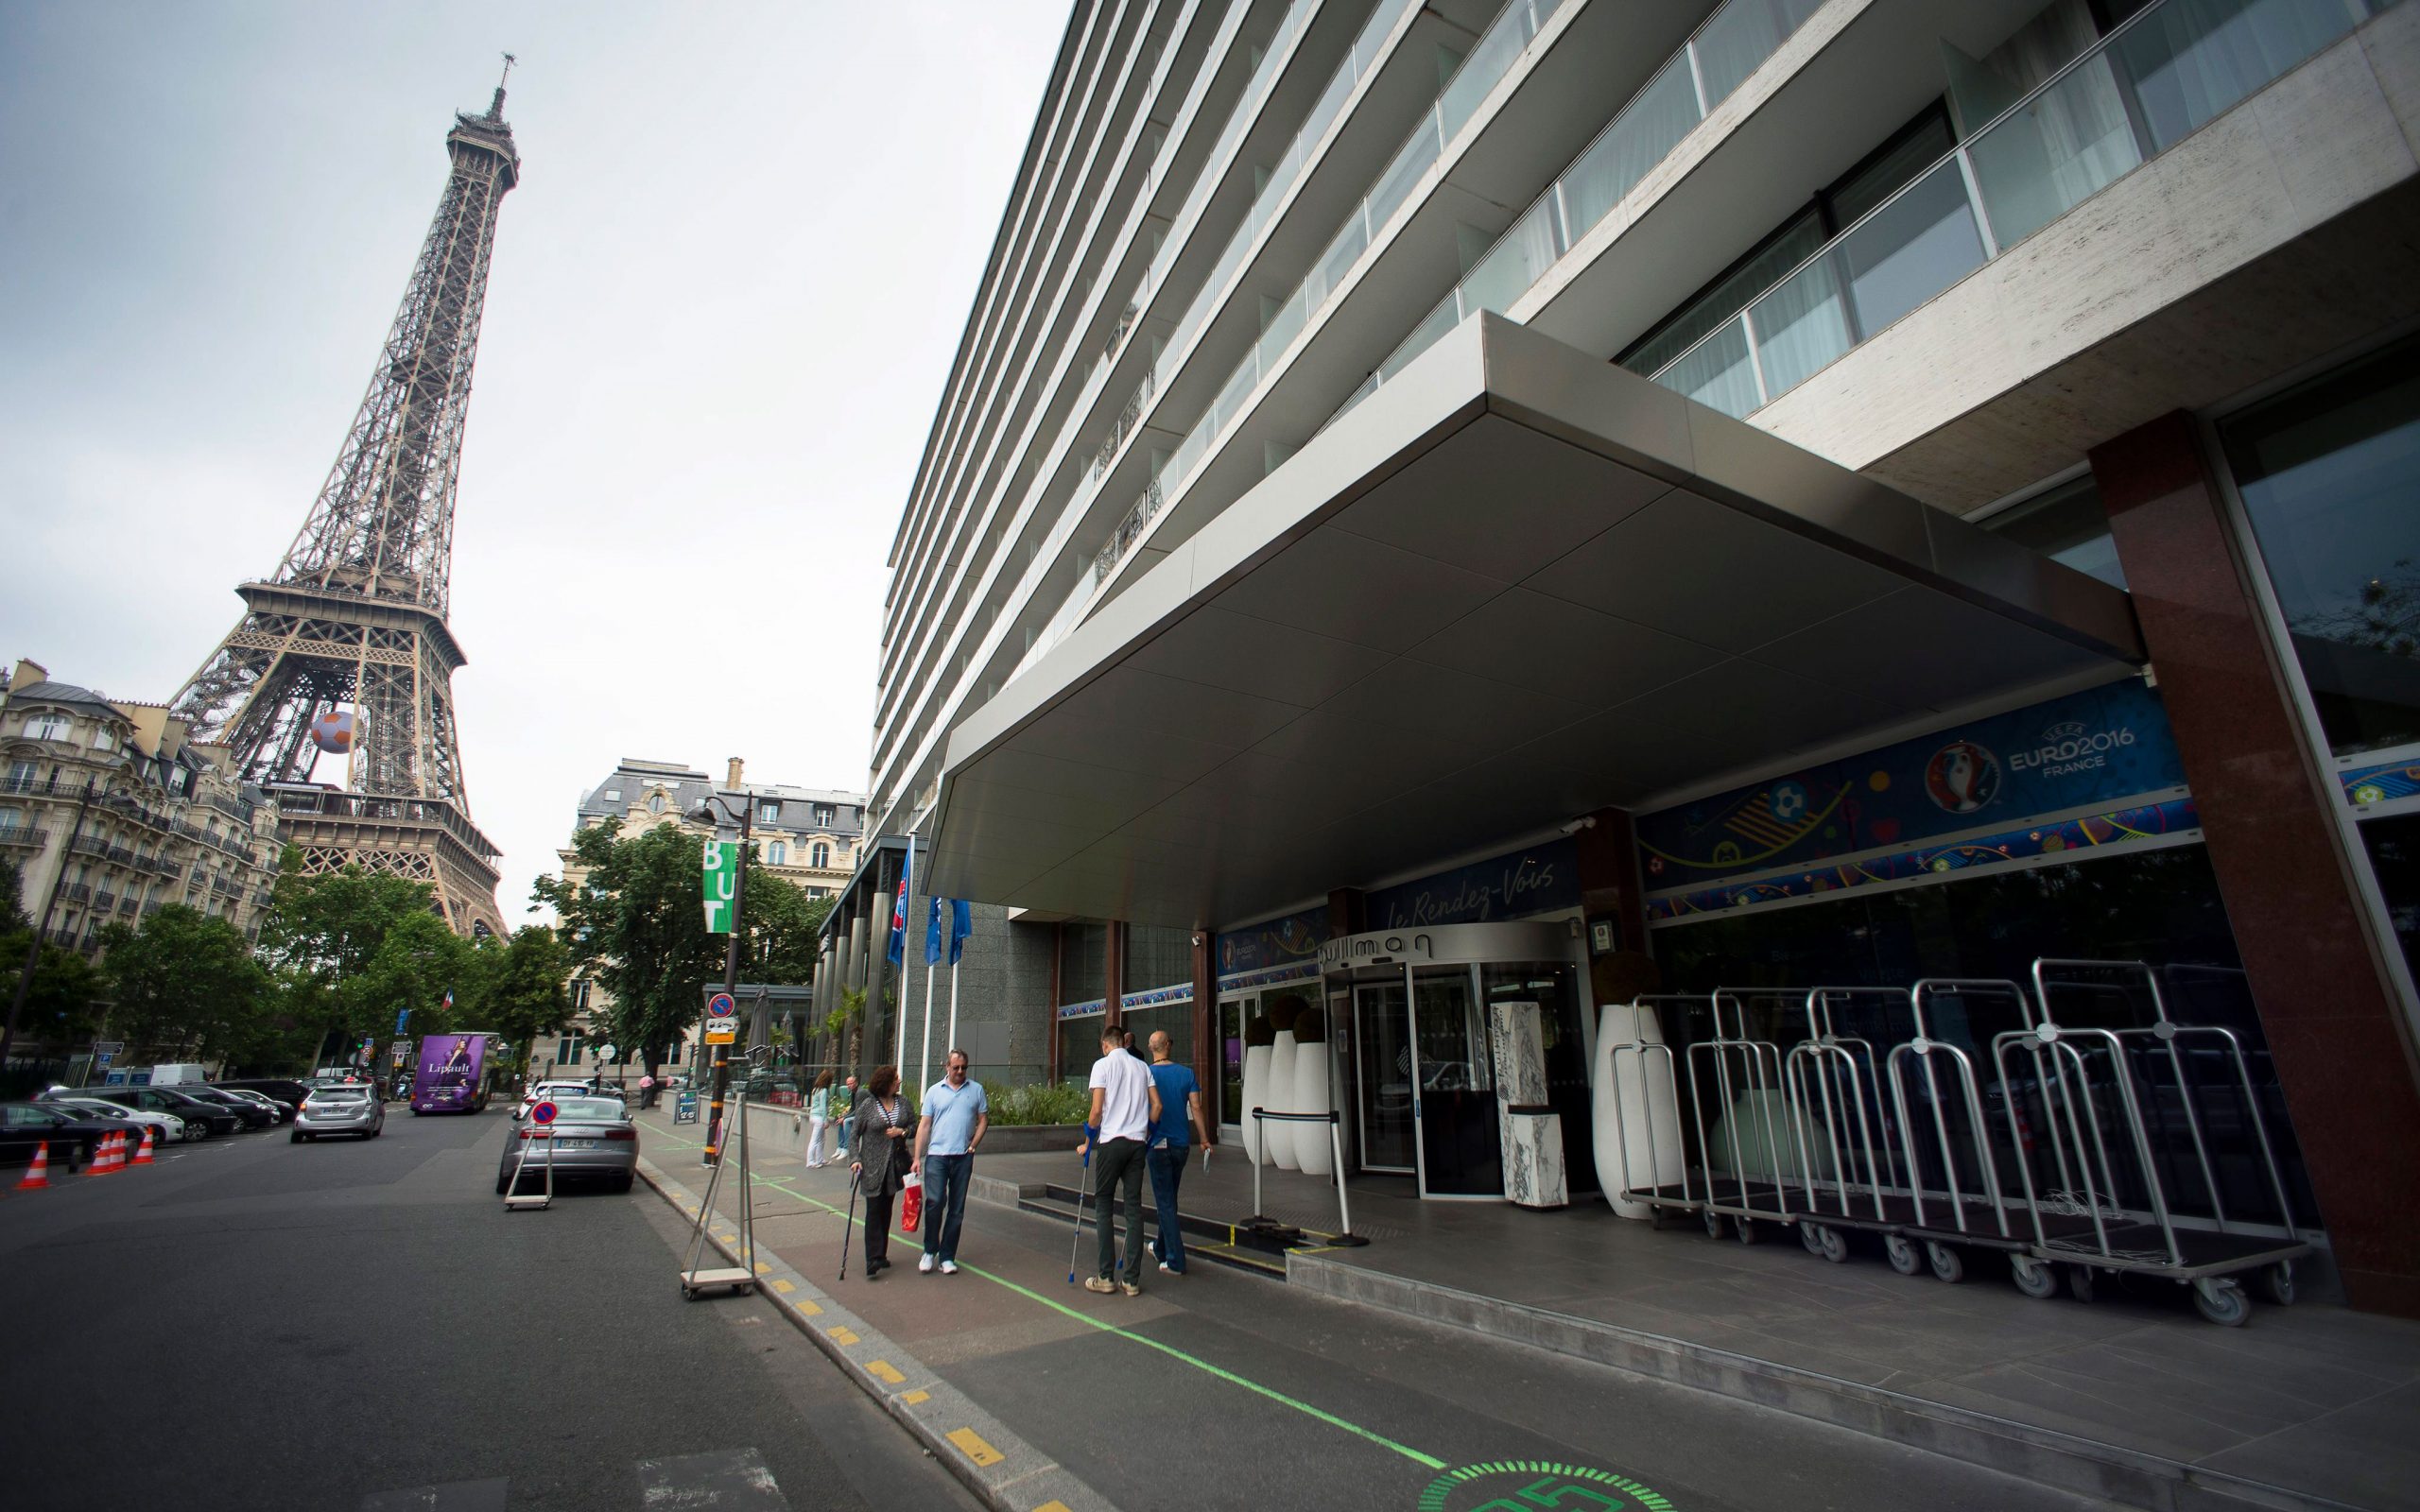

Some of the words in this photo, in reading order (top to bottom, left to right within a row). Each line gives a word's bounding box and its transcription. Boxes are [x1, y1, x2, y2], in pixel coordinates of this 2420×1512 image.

[2047, 724, 2083, 741] UEFA
[2008, 727, 2135, 771] EURO2016
[2042, 755, 2106, 779] FRANCE
[1411, 855, 1555, 927] Rendez-Vous
[1317, 934, 1433, 973] pullman
[428, 1063, 470, 1074] Lipault
